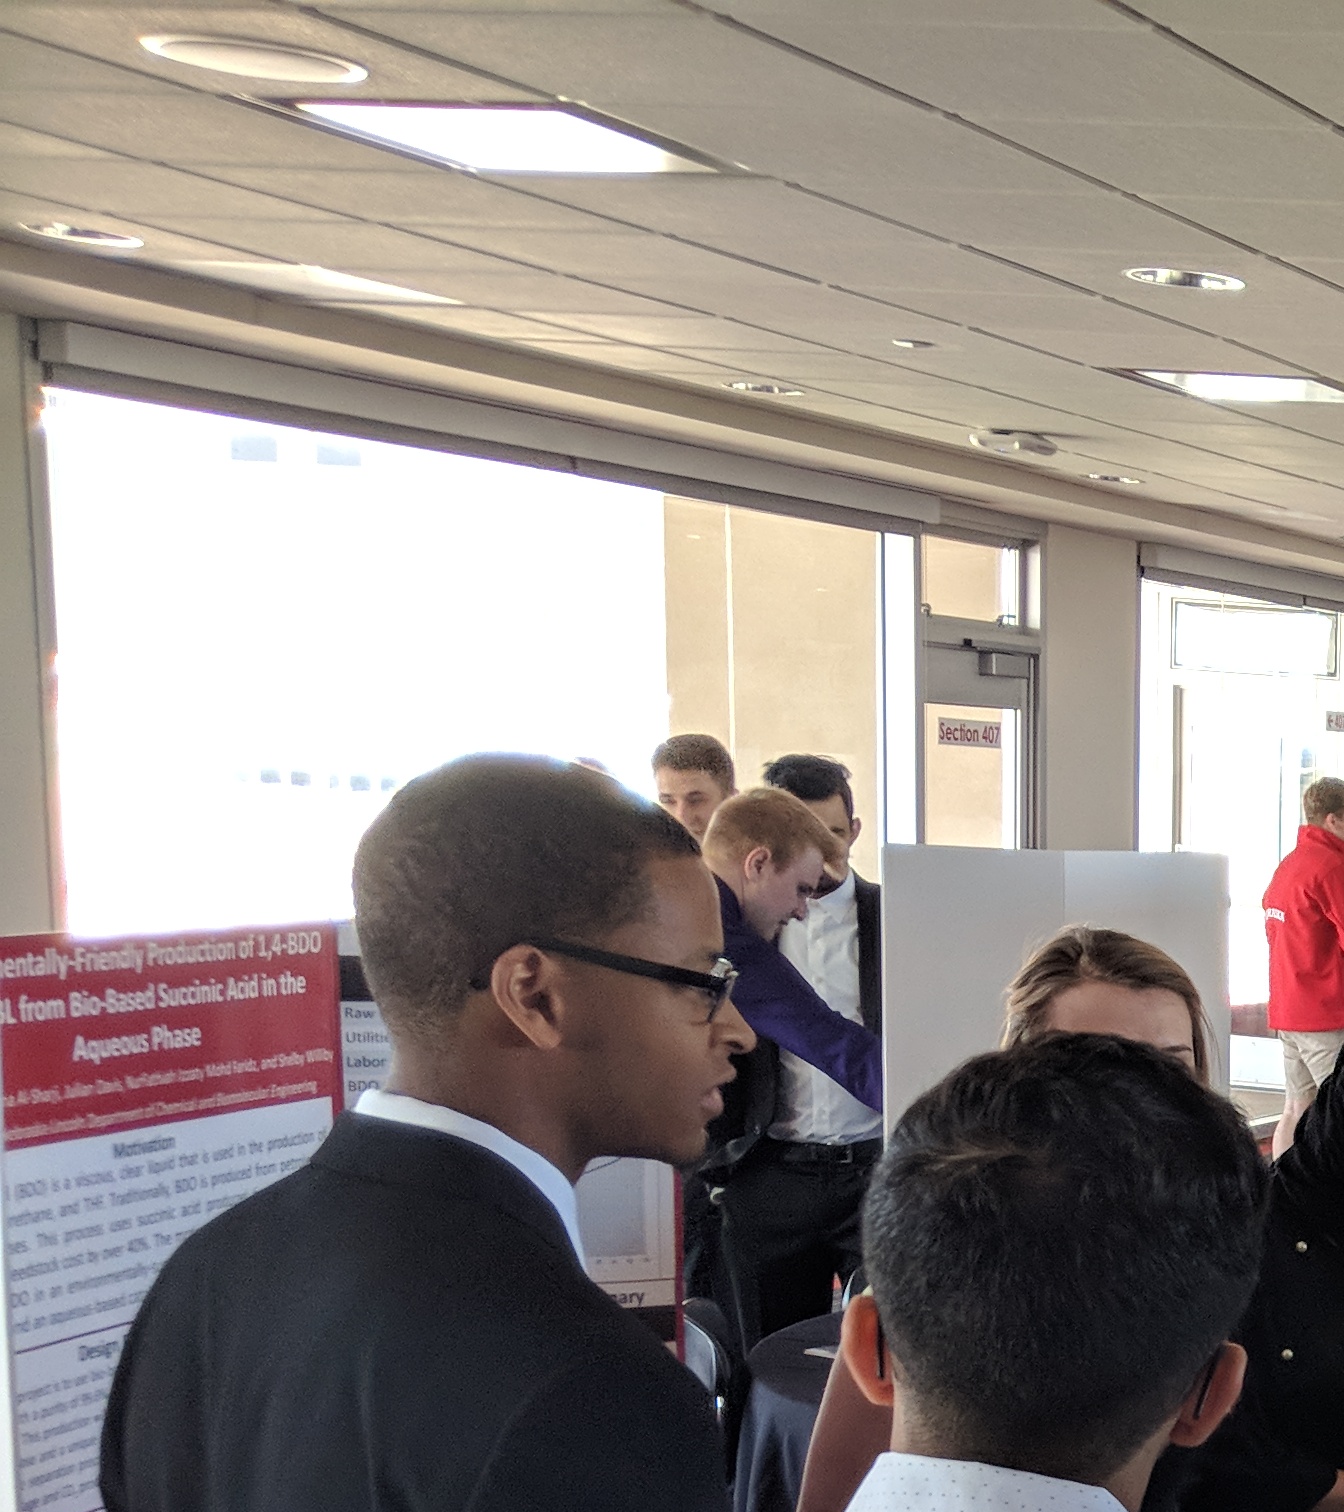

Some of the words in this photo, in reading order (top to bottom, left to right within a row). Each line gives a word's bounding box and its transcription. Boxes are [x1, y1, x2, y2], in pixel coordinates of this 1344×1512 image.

[939, 722, 979, 742] Section
[982, 725, 1000, 743] 407
[0, 942, 144, 980] entally-Friendly
[146, 938, 235, 966] Production
[239, 934, 254, 959] of
[256, 931, 322, 961] 1,4-BDO
[18, 994, 66, 1023] from
[69, 983, 156, 1018] Bio-Based
[157, 978, 224, 1008] Succinic
[226, 974, 258, 1001] Acid
[261, 973, 277, 997] in
[279, 970, 306, 995] the
[345, 1007, 376, 1019] Raw
[73, 1033, 149, 1064] Aqueous
[151, 1024, 202, 1050] Phase
[346, 1056, 387, 1068] Labor
